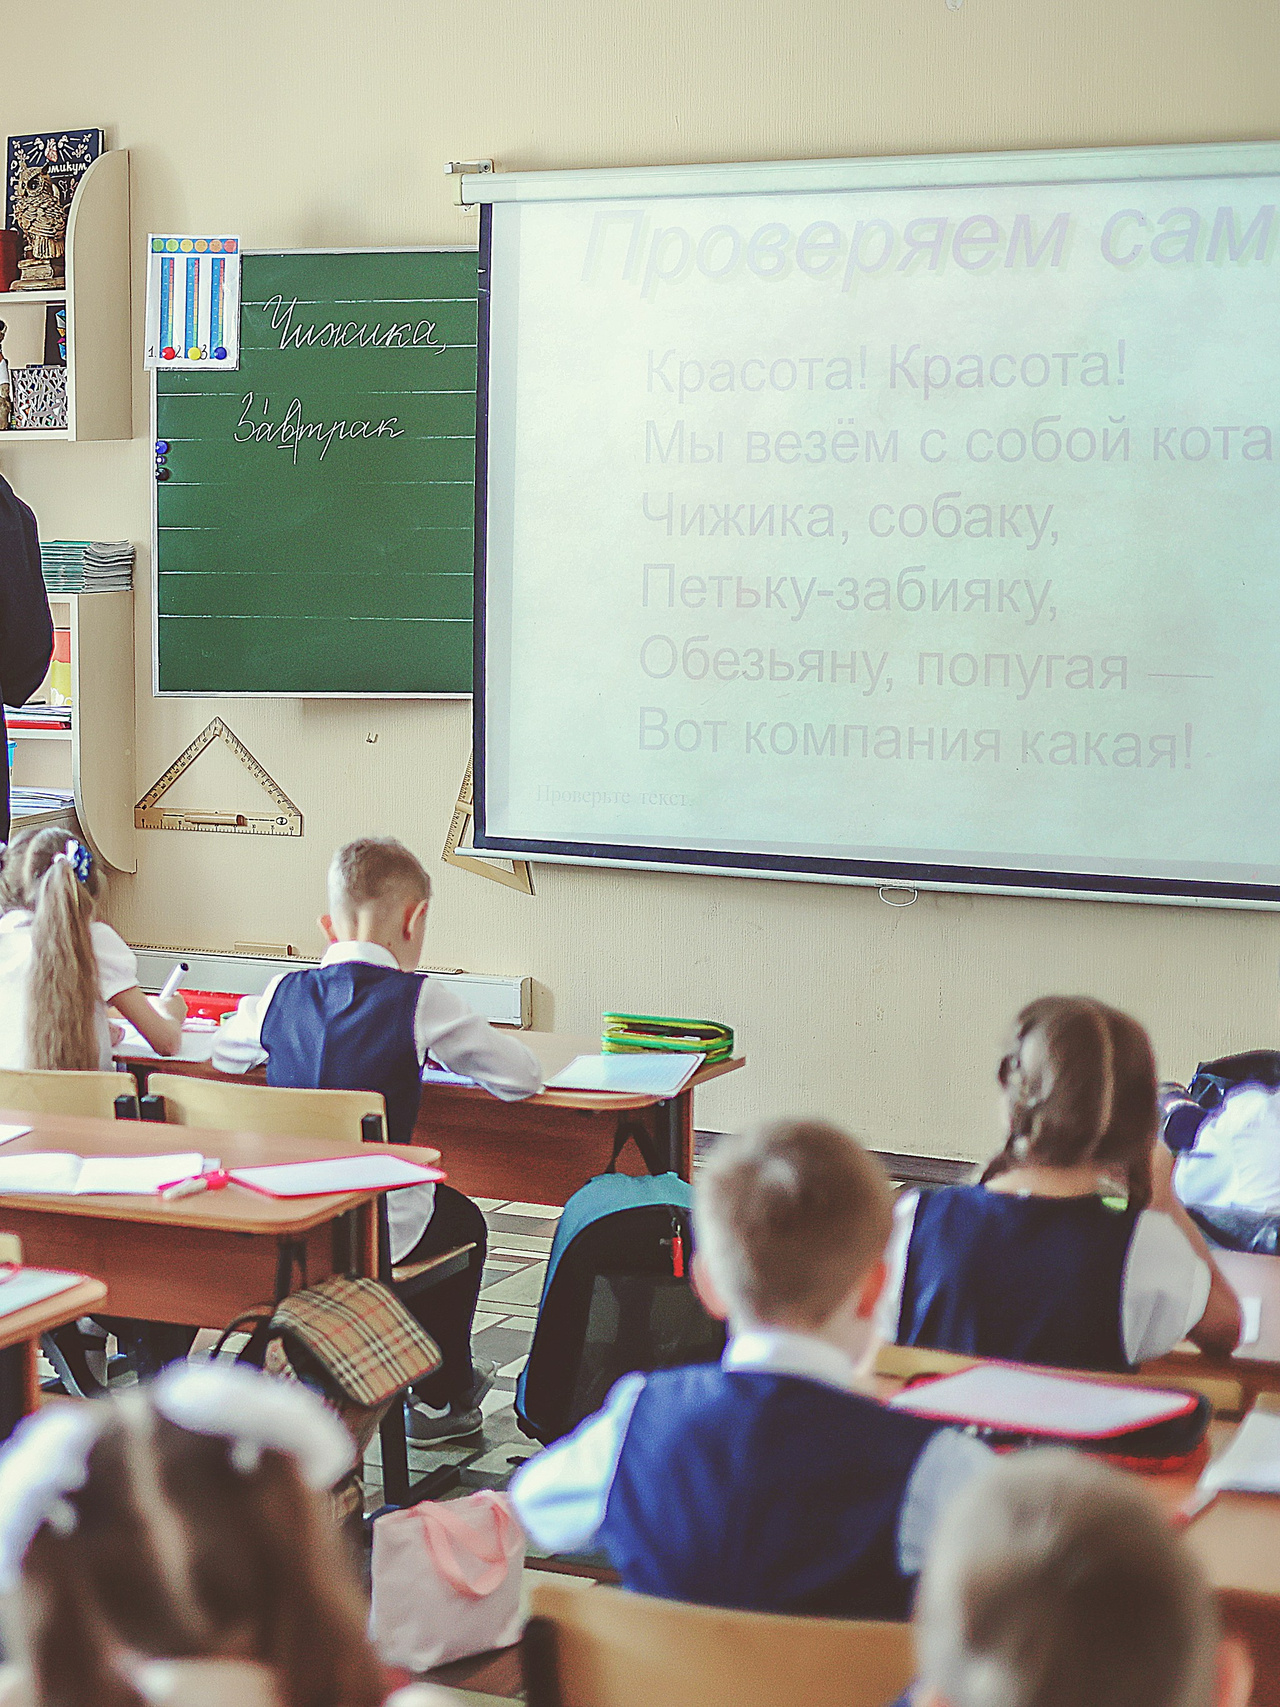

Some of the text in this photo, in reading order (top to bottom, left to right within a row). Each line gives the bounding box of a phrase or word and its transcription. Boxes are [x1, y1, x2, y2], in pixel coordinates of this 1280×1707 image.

[581, 209, 1073, 300] Проверяем
[263, 294, 447, 355] Чижика,
[646, 339, 1126, 404] Красота! Красота!
[645, 414, 1273, 464] Мы везём с собой кота
[642, 490, 1058, 550] Чижика, собаку,
[642, 563, 1057, 625] Петьку-забияку,
[640, 634, 893, 697] Обезьяну,
[918, 652, 1128, 700] попугая
[639, 706, 1193, 770] Вот компания какая!
[537, 785, 631, 808] Проверьте
